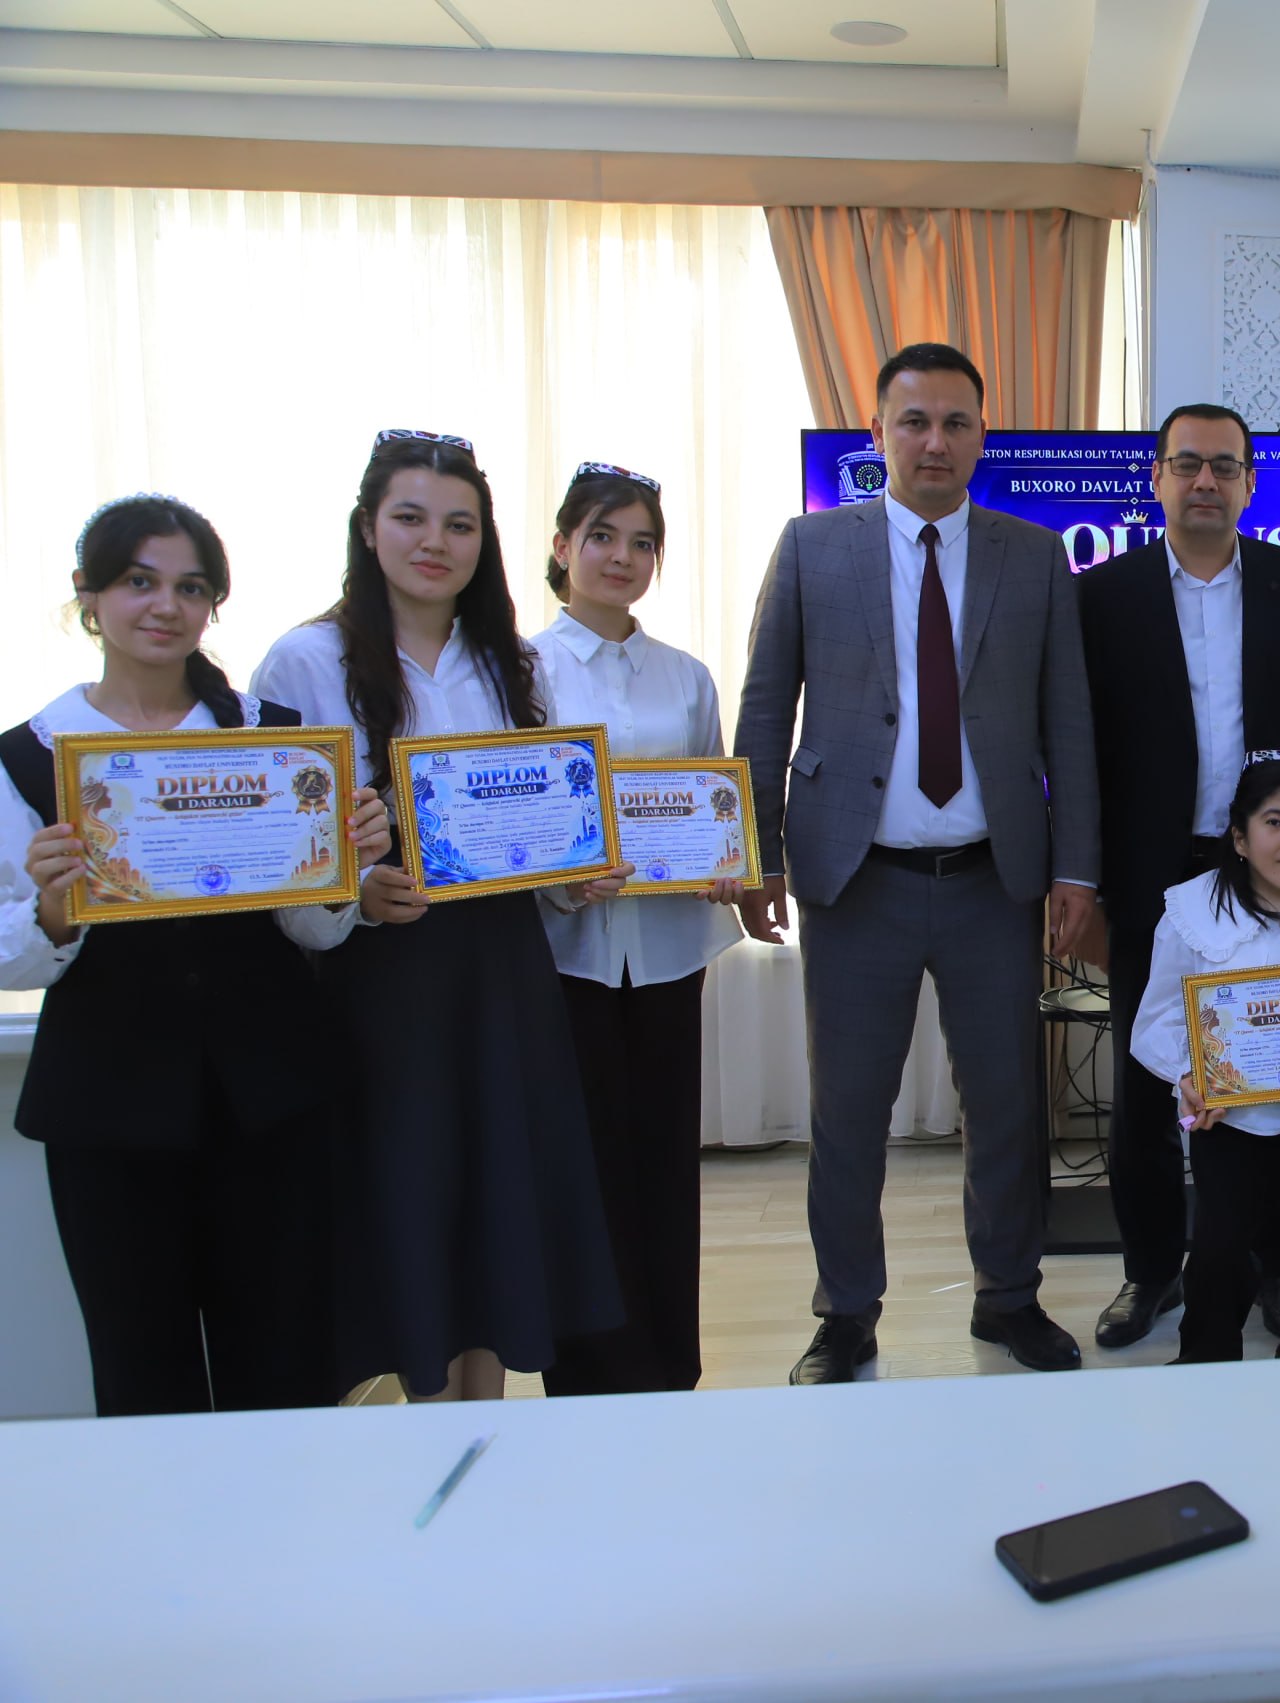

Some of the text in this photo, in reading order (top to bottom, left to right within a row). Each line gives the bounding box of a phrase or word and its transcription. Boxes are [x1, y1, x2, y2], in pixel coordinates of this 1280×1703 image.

[1014, 449, 1083, 459] RESPUBLIKASI
[1084, 449, 1107, 460] OLIY
[1010, 480, 1076, 493] BUXORO
[1081, 480, 1143, 493] DAVLAT
[466, 765, 548, 787] DIPLOM
[156, 773, 268, 796] DIPLOM
[481, 784, 538, 798] II DARAJALI
[178, 796, 252, 809] I DARAJALI
[619, 791, 695, 806] DIPLOM
[641, 807, 684, 816] DARAJALI
[1261, 1017, 1265, 1025] I
